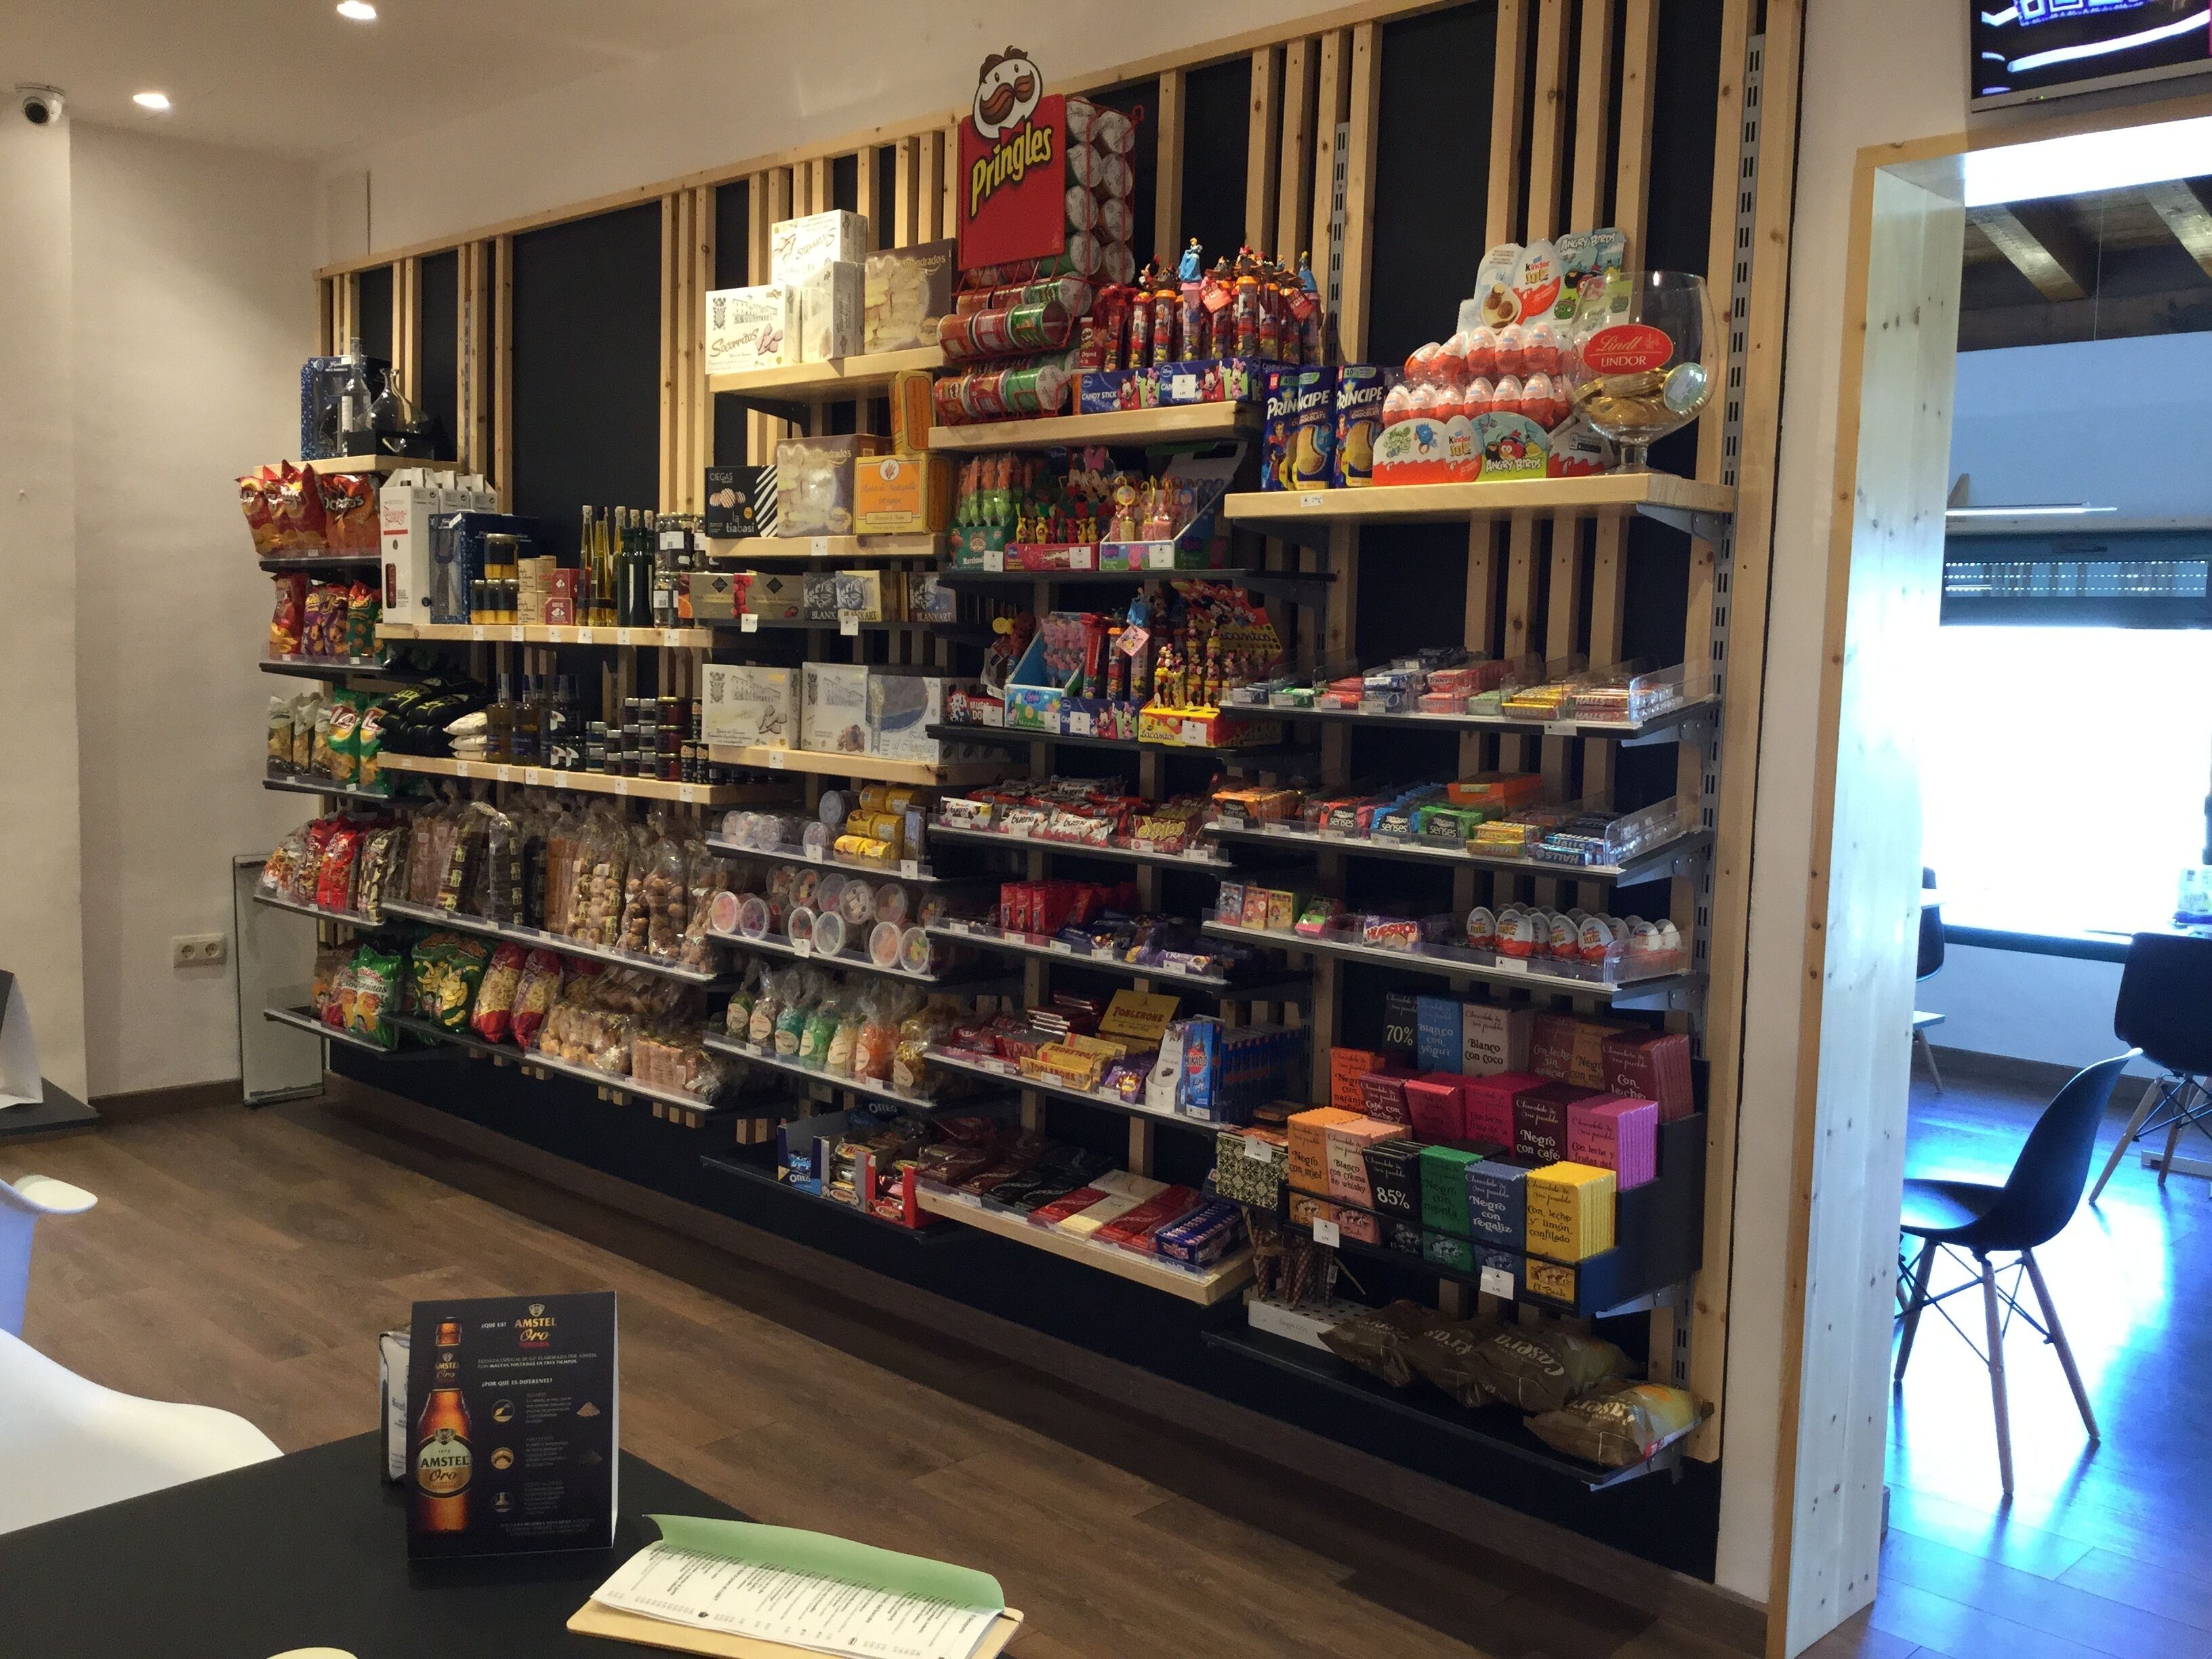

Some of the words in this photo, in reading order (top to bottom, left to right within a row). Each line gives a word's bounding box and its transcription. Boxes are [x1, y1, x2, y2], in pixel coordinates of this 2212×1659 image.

[970, 123, 1052, 217] Pringles
[1560, 237, 1588, 253] ANGRY
[1591, 232, 1616, 246] BIRDS
[1525, 260, 1550, 271] kinder
[710, 328, 759, 357] Socorritos
[1595, 335, 1643, 351] Lindt
[1601, 356, 1647, 367] LINDOR
[1082, 392, 1100, 401] CANDY
[1449, 435, 1471, 445] kinder
[1486, 458, 1513, 472] ANGRY
[1515, 457, 1542, 470] BIRDS
[709, 472, 733, 481] CIEGAS
[732, 510, 739, 523] la
[725, 521, 755, 533] tiabasi
[811, 611, 837, 620] BLANX
[916, 612, 952, 623] BLANXART
[1220, 630, 1272, 642] acasitos
[1576, 697, 1607, 705] HALLS
[972, 710, 983, 720] DO
[1576, 712, 1605, 720] HALLS
[1140, 729, 1174, 741] Lacasitos
[1061, 787, 1084, 796] bueno
[950, 805, 968, 813] bueno
[1334, 809, 1355, 819] Trident
[1011, 815, 1034, 824] bueno
[1063, 817, 1088, 827] bueno
[1330, 817, 1354, 827] senses
[1385, 815, 1408, 824] Trident
[1433, 818, 1455, 827] Trident
[1381, 823, 1408, 833] senses
[1430, 825, 1456, 837] senses
[1552, 839, 1585, 851] HALLS
[1545, 851, 1580, 864] HALLS
[1112, 1006, 1164, 1023] TOBLERONE
[1400, 1004, 1417, 1017] puebl
[1386, 1024, 1414, 1046] 70%
[1417, 1023, 1454, 1037] Blanco
[1426, 1036, 1446, 1047] con
[1467, 1038, 1501, 1054] Blanco
[1465, 1050, 1480, 1061] con
[1482, 1052, 1504, 1065] coco
[1549, 1046, 1572, 1061] leche
[1602, 1045, 1635, 1058] Chocolate
[1185, 1055, 1208, 1067] MIKADO
[1545, 1057, 1561, 1068] sin
[1576, 1054, 1602, 1070] Negr
[1624, 1058, 1648, 1070] pueblo
[1030, 1062, 1076, 1082] TOBLERONE
[1334, 1073, 1359, 1084] Negr
[1617, 1073, 1640, 1089] Con
[1342, 1085, 1359, 1096] con
[1611, 1084, 1647, 1099] leche
[868, 1103, 898, 1115] OREO
[1366, 1099, 1383, 1111] Café
[1385, 1105, 1404, 1115] con
[1516, 1099, 1547, 1112] Chocolate
[1535, 1113, 1559, 1126] pueblo
[1519, 1129, 1556, 1148] Negro
[1516, 1143, 1534, 1154] con
[1572, 1141, 1586, 1151] Con
[1588, 1143, 1607, 1155] leche
[1609, 1151, 1615, 1160] y
[1292, 1150, 1319, 1166] Negro
[1365, 1155, 1394, 1168] Chocolate
[1574, 1152, 1598, 1166] frutas
[1600, 1158, 1612, 1168] del
[1289, 1163, 1303, 1174] con
[1305, 1168, 1322, 1180] miel
[1334, 1158, 1360, 1172] Blanco
[790, 1173, 811, 1183] OREO
[1330, 1168, 1342, 1177] con
[1343, 1171, 1366, 1184] crema
[1385, 1168, 1406, 1179] pueblo
[1341, 1179, 1366, 1193] whisky
[1425, 1178, 1457, 1194] Negro
[1465, 1173, 1497, 1189] Chocolate
[1527, 1178, 1559, 1193] Chocolate
[1376, 1186, 1410, 1210] 85%
[1486, 1187, 1510, 1199] pueblo
[1547, 1193, 1572, 1206] pueblo
[1432, 1195, 1452, 1206] con
[1469, 1195, 1507, 1212] Negro
[1423, 1202, 1458, 1218] menta
[1481, 1210, 1501, 1221] con
[1528, 1204, 1544, 1216] Con
[1548, 1209, 1572, 1223] leche
[1473, 1216, 1513, 1233] regaliz
[1528, 1217, 1539, 1226] y
[1542, 1218, 1573, 1235] limón
[1528, 1228, 1571, 1244] confitado
[514, 1317, 557, 1328] AMSTEL
[519, 1328, 550, 1342] Oro
[519, 1377, 553, 1385] DIFERENTE?
[420, 1455, 470, 1469] AMSTEL
[430, 1469, 457, 1481] Oro
